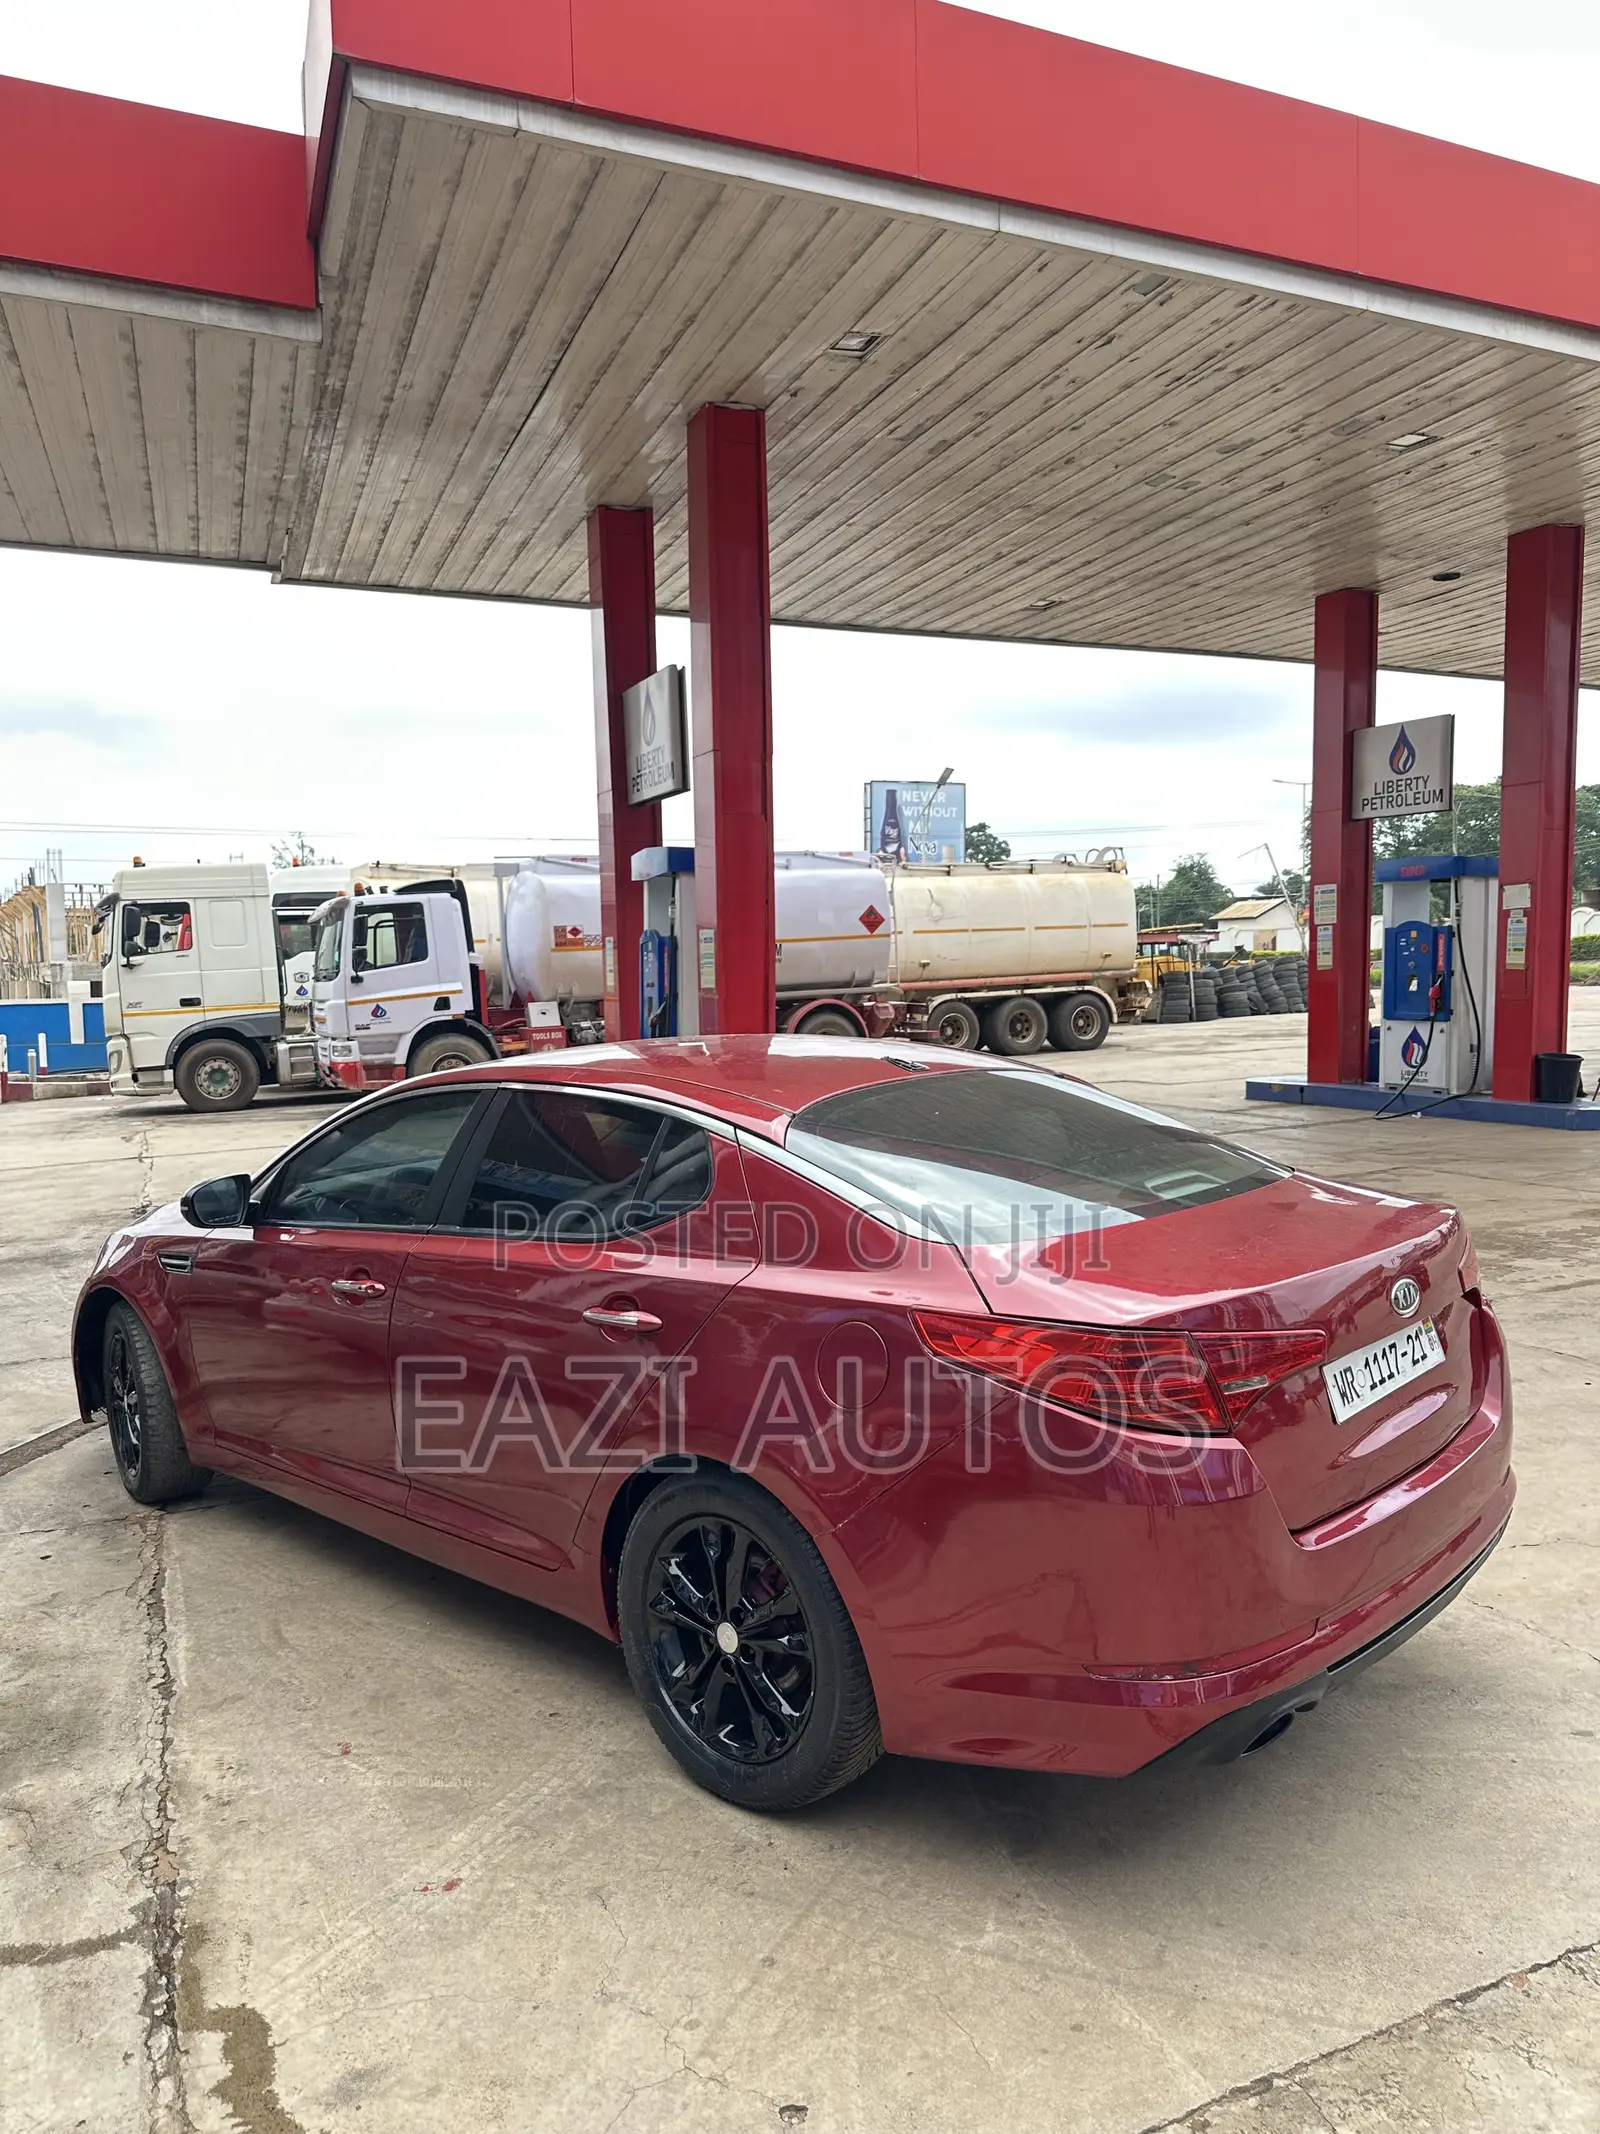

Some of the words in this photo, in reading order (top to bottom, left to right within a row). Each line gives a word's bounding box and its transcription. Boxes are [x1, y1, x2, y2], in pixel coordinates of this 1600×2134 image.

[636, 745, 665, 772] LIBERTY
[631, 761, 675, 794] PETROLEUM
[1374, 775, 1430, 795] LIBERTY
[902, 790, 946, 803] NEVER
[1361, 788, 1444, 812] PETROLEUM
[902, 805, 958, 818] WITHOUT
[532, 1032, 550, 1041] TOOLS
[551, 1031, 563, 1039] BOX
[1396, 1285, 1418, 1309] KIA
[1333, 1365, 1360, 1406] WR
[1364, 1328, 1427, 1391] 1117-21
